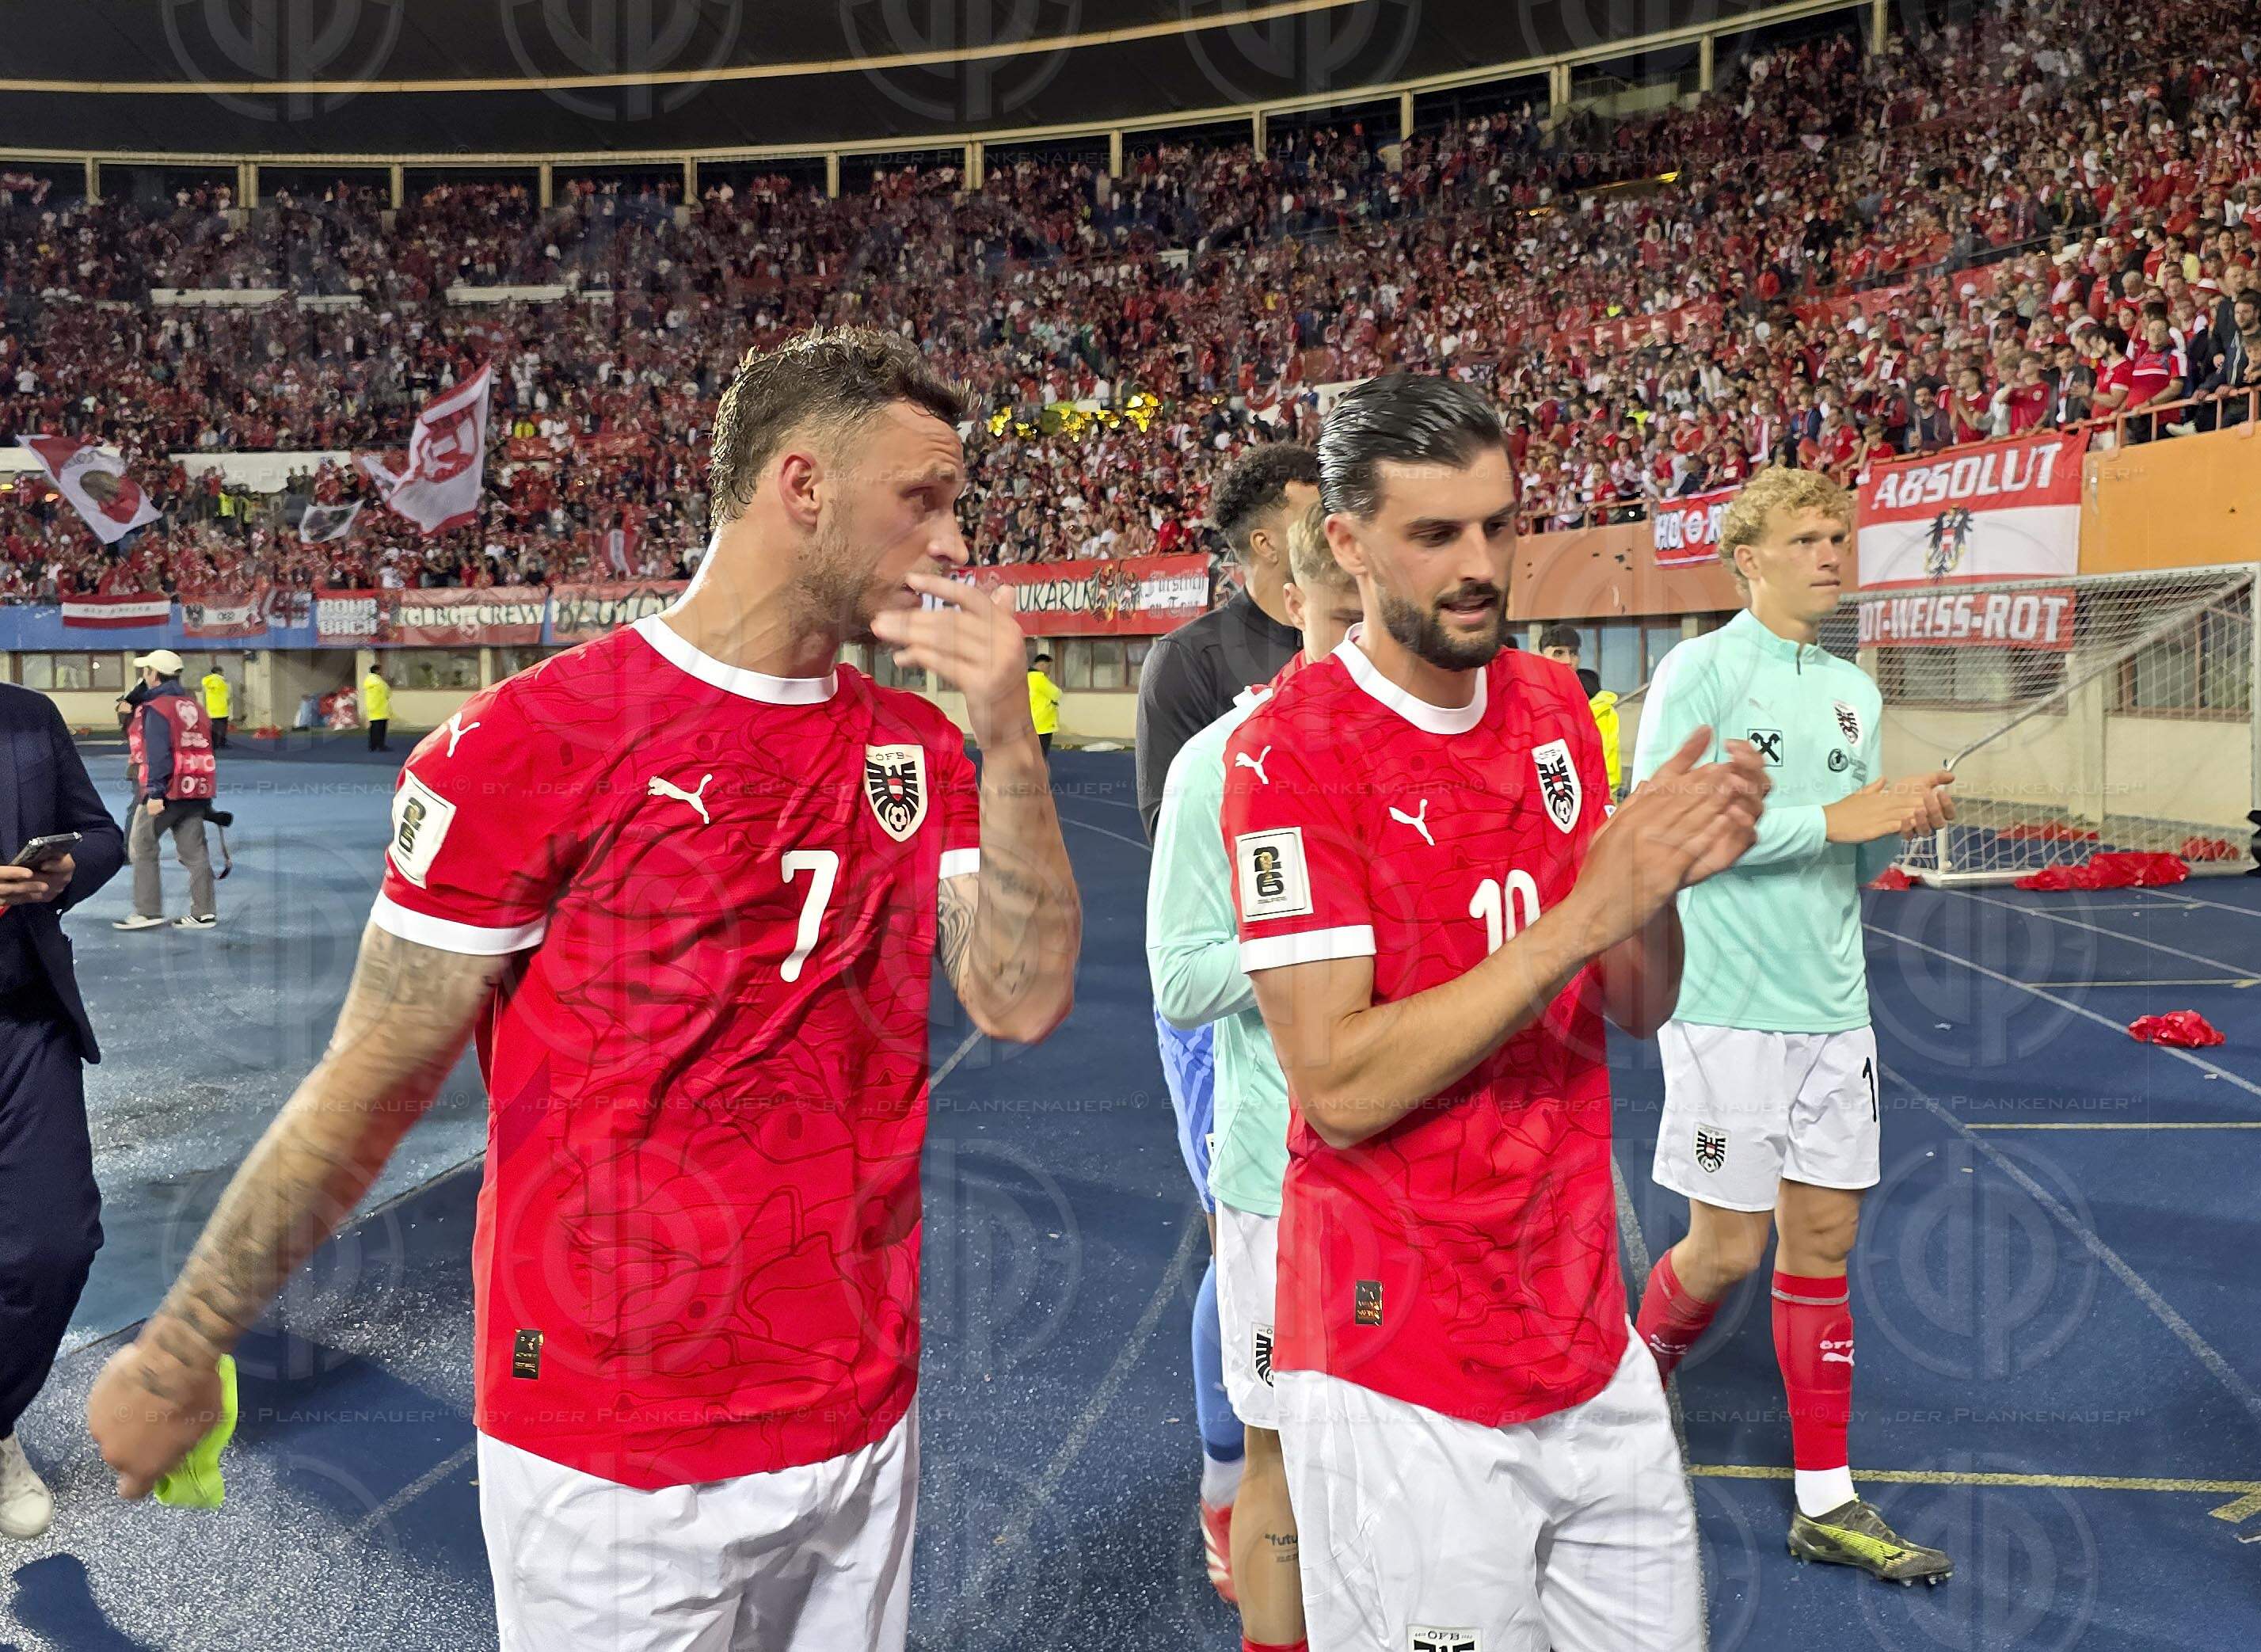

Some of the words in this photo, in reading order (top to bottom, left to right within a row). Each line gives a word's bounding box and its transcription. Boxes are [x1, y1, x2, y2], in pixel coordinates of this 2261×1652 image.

[1871, 442, 2063, 510] ABSOLUT
[780, 850, 839, 982] 7
[1469, 869, 1540, 955] 10
